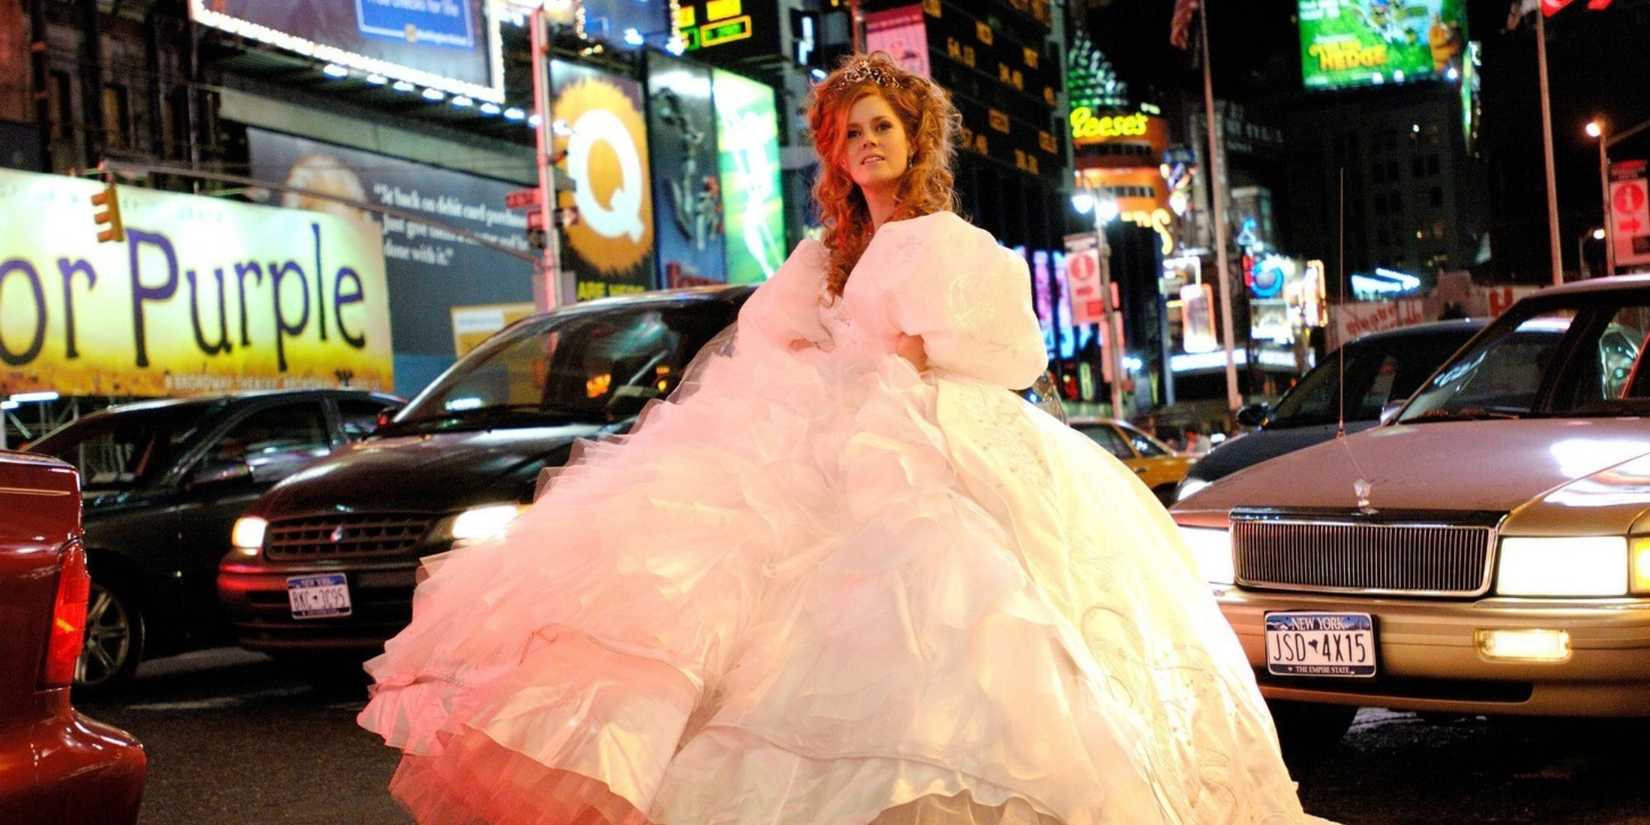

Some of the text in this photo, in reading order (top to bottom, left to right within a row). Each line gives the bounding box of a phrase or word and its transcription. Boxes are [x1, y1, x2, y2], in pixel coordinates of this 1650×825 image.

[1070, 106, 1149, 138] Reese's
[567, 108, 645, 245] Q
[126, 222, 366, 373] Purple
[1291, 615, 1346, 630] NEW YORK
[1273, 633, 1366, 663] JSD 4X15
